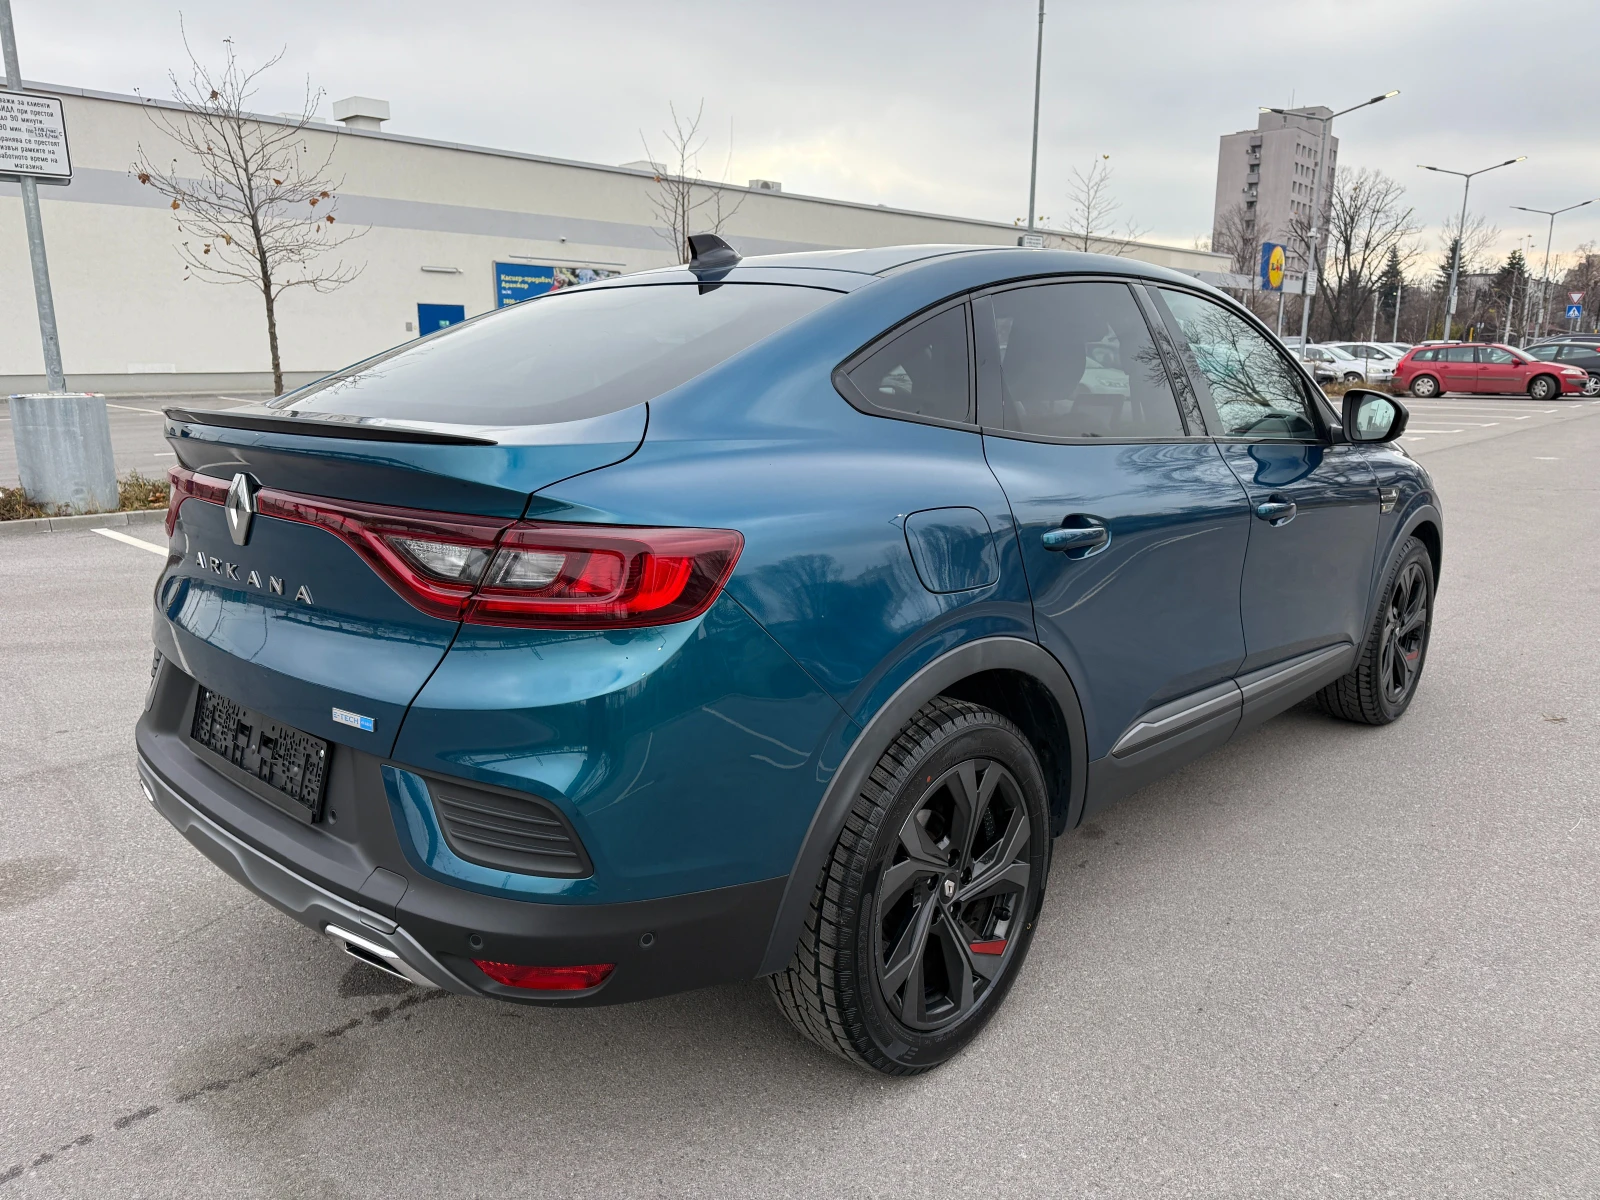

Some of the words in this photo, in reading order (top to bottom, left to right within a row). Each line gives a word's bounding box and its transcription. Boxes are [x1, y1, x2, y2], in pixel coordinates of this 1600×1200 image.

[27, 101, 50, 109] клиенти
[30, 109, 54, 117] престой
[10, 114, 18, 122] 90
[21, 146, 45, 154] рамките
[196, 551, 315, 605] ARKANA
[333, 711, 359, 725] E-TECH
